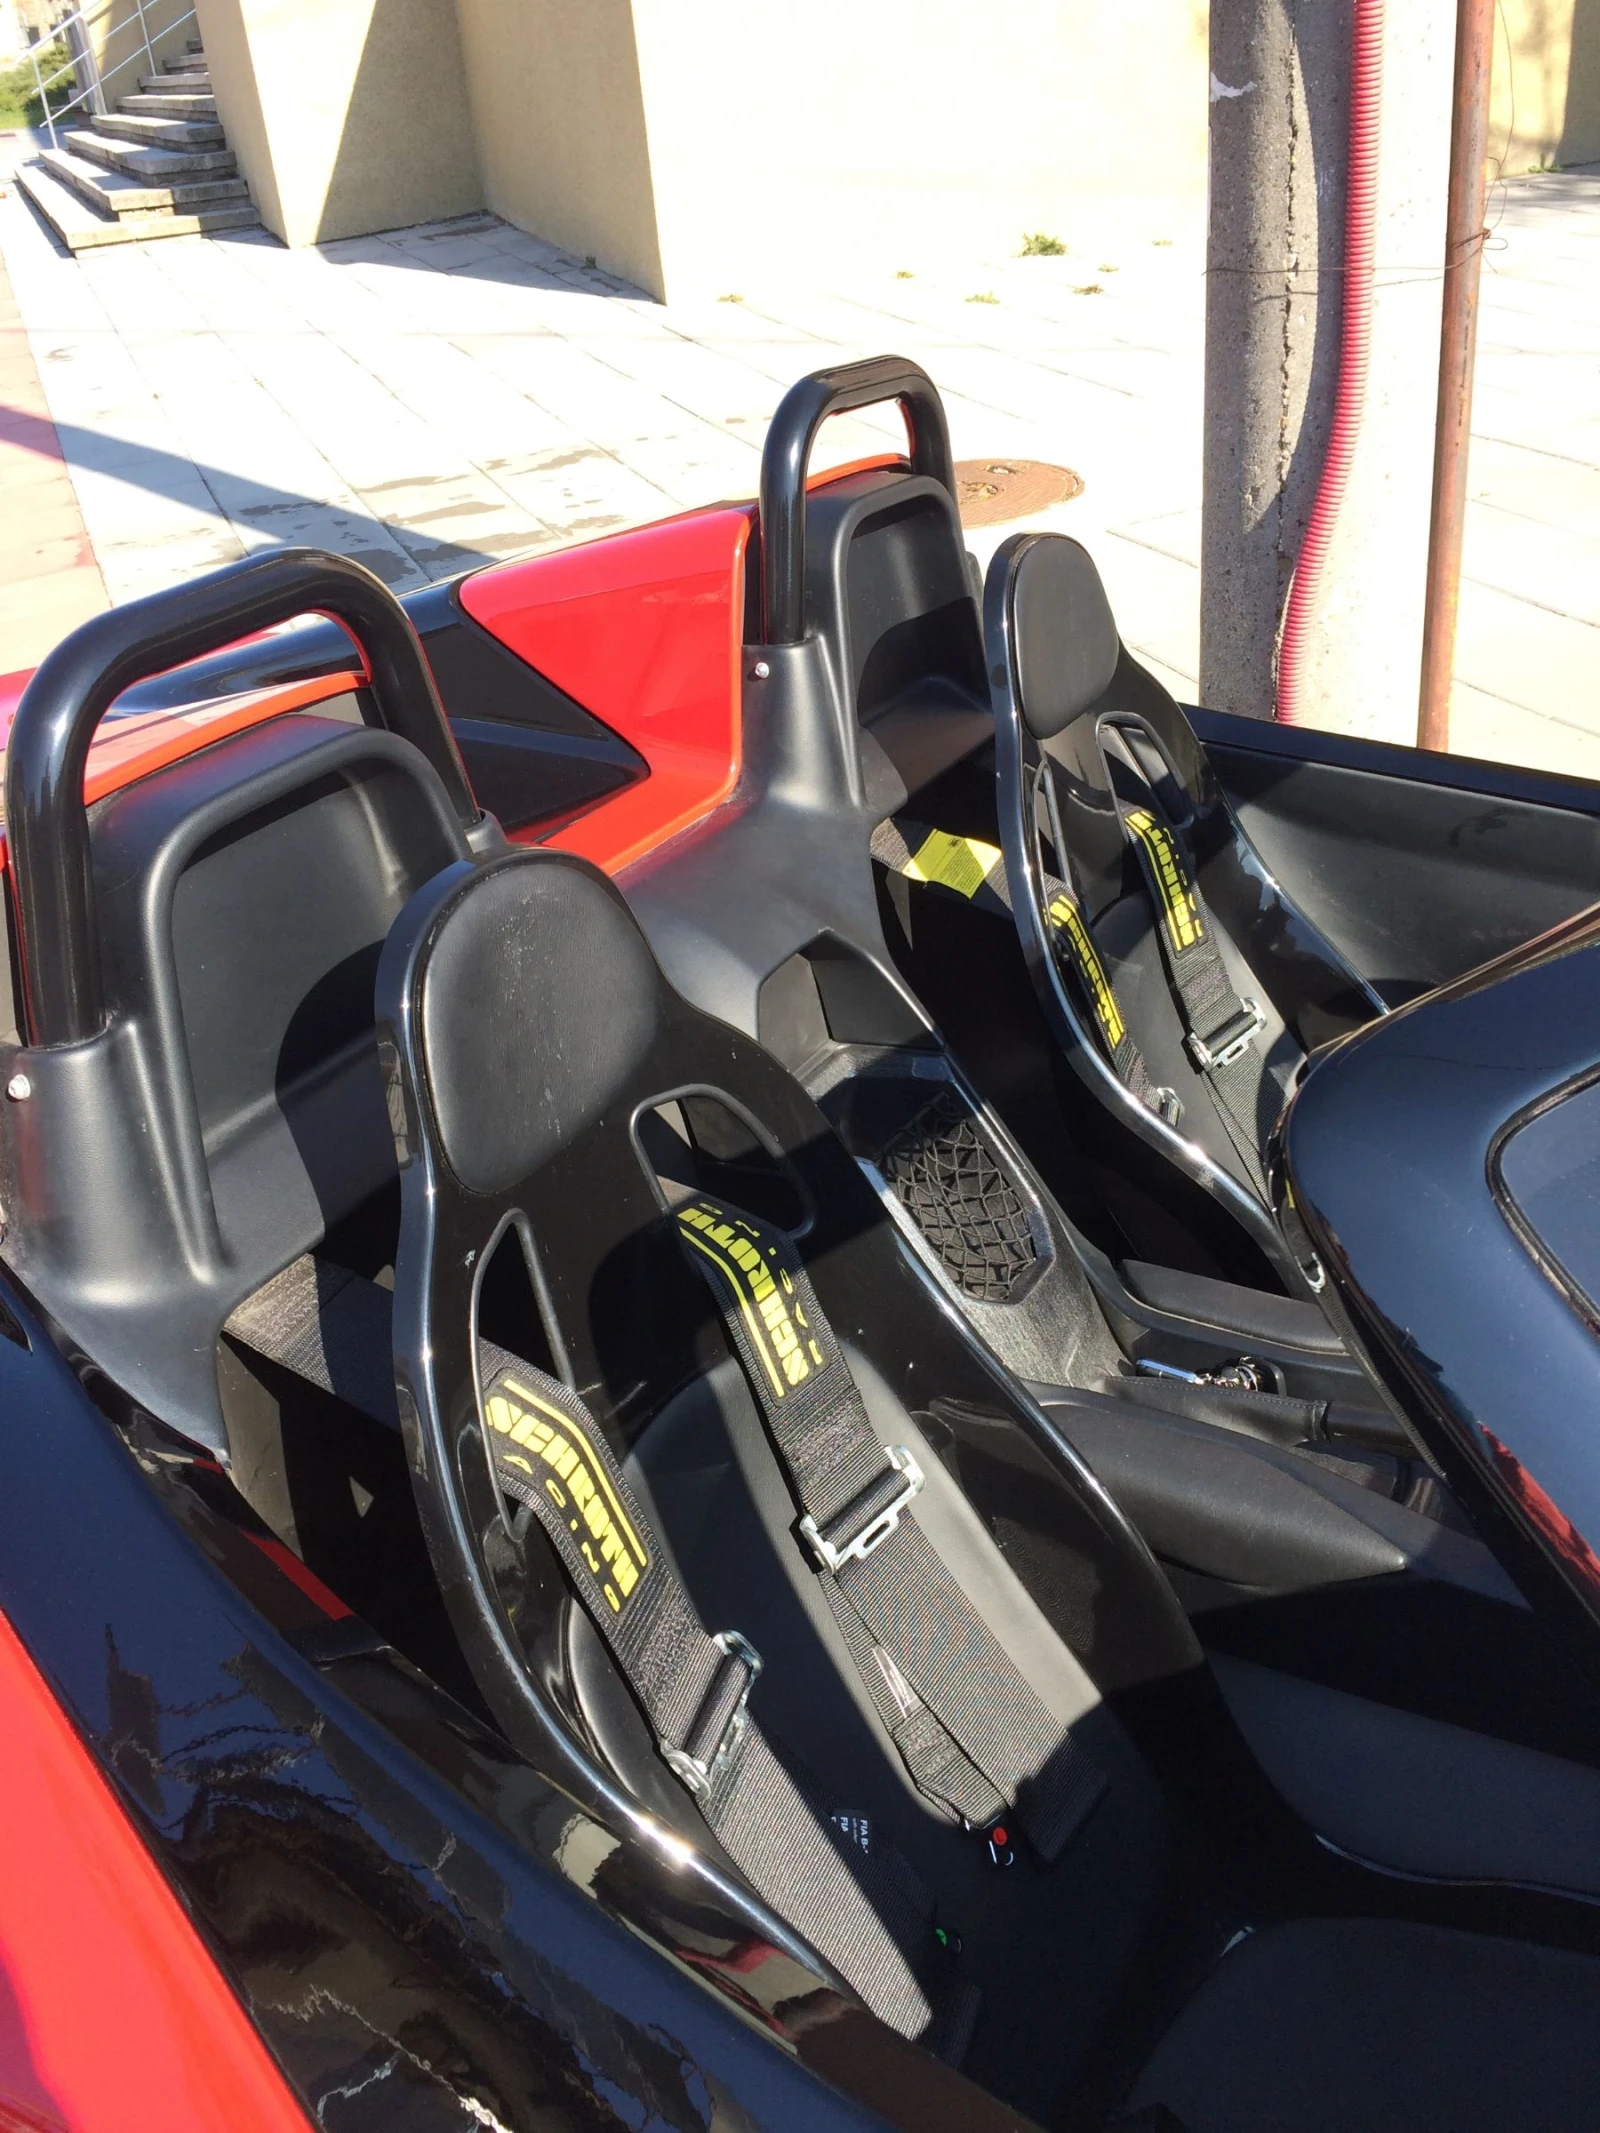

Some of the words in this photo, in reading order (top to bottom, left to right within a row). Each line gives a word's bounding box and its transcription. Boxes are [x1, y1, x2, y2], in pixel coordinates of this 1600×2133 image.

[1129, 812, 1195, 946] SCHROTH
[1050, 902, 1121, 1044] SCHROTH
[677, 1208, 808, 1385] SCHROTH
[700, 1203, 822, 1365] RACING
[485, 1397, 639, 1597] SCHROTH
[503, 1455, 620, 1612] ACING
[860, 1819, 869, 1836] FIA
